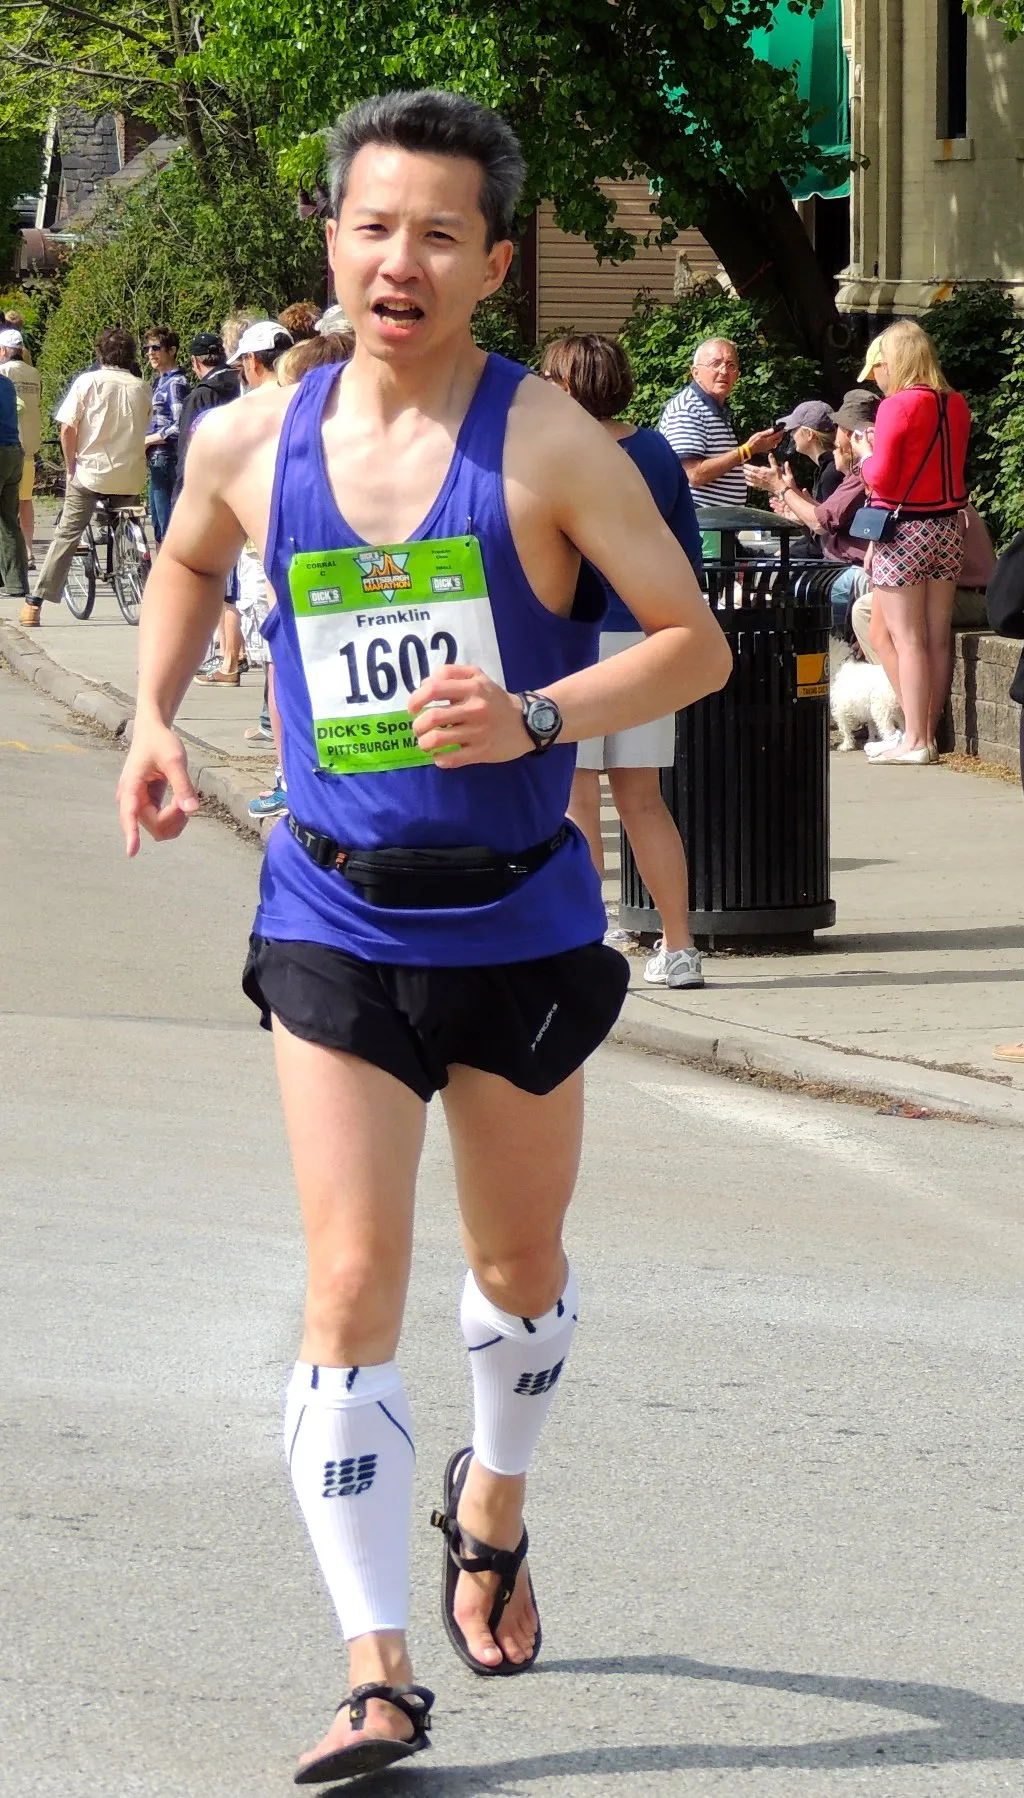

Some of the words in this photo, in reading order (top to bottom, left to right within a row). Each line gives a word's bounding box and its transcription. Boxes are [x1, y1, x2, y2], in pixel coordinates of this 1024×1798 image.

[364, 581, 411, 591] MARATHON
[356, 608, 431, 628] Franklin
[317, 723, 371, 740] DICK'S
[328, 739, 400, 756] PITTSBURGH
